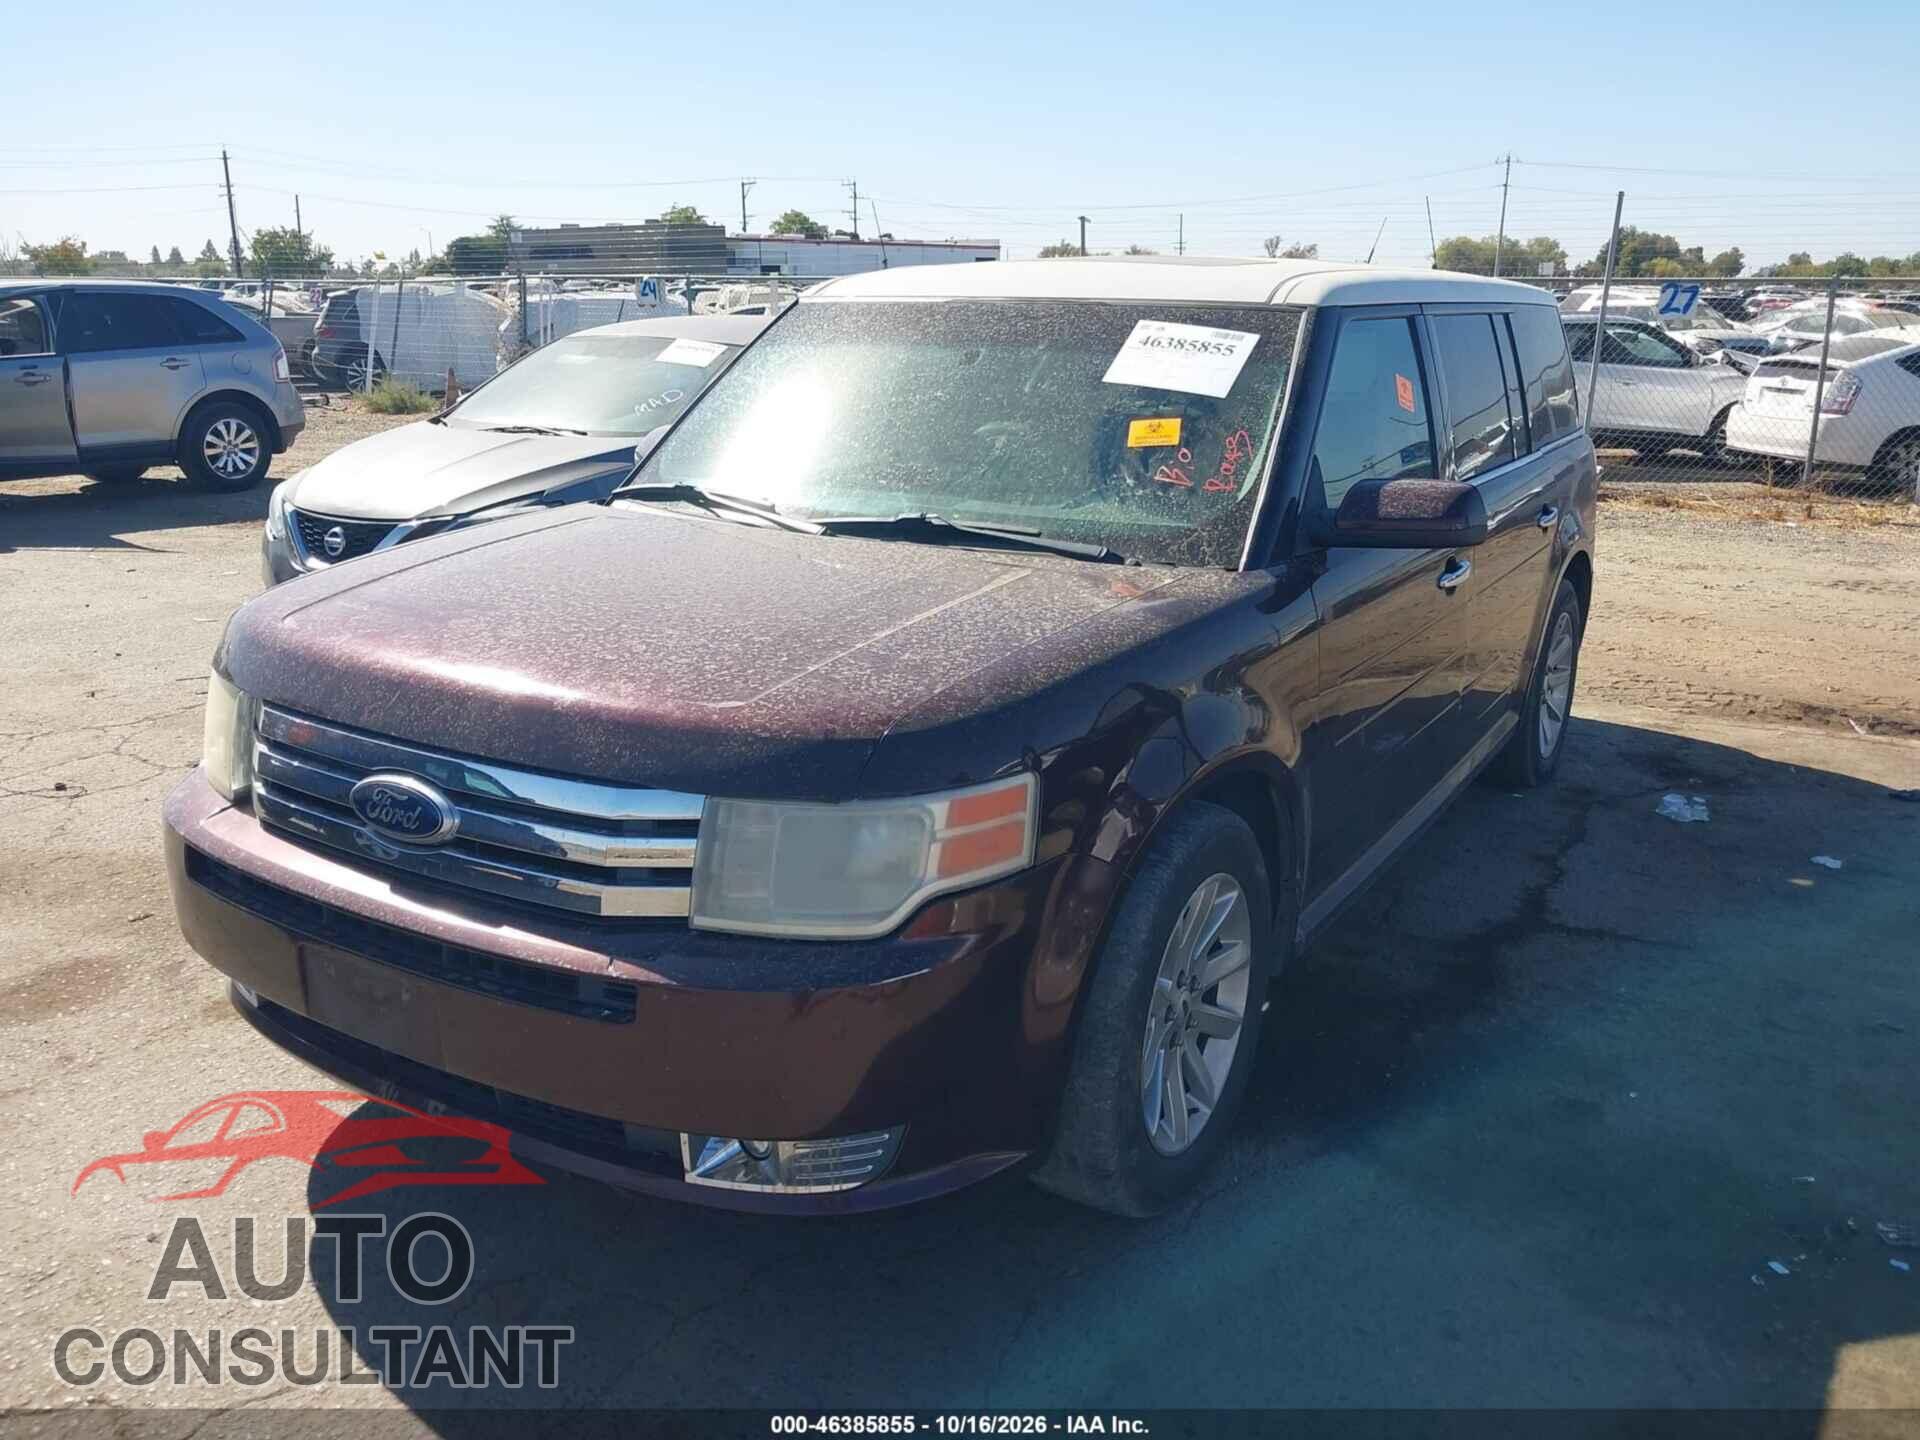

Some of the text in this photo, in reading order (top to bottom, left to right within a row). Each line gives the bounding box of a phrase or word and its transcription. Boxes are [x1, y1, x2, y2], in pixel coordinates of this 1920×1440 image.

[641, 280, 657, 300] 24
[1659, 283, 1699, 315] 27
[1138, 335, 1237, 357] 46385855
[633, 389, 684, 416] MAD
[366, 787, 422, 830] Ford
